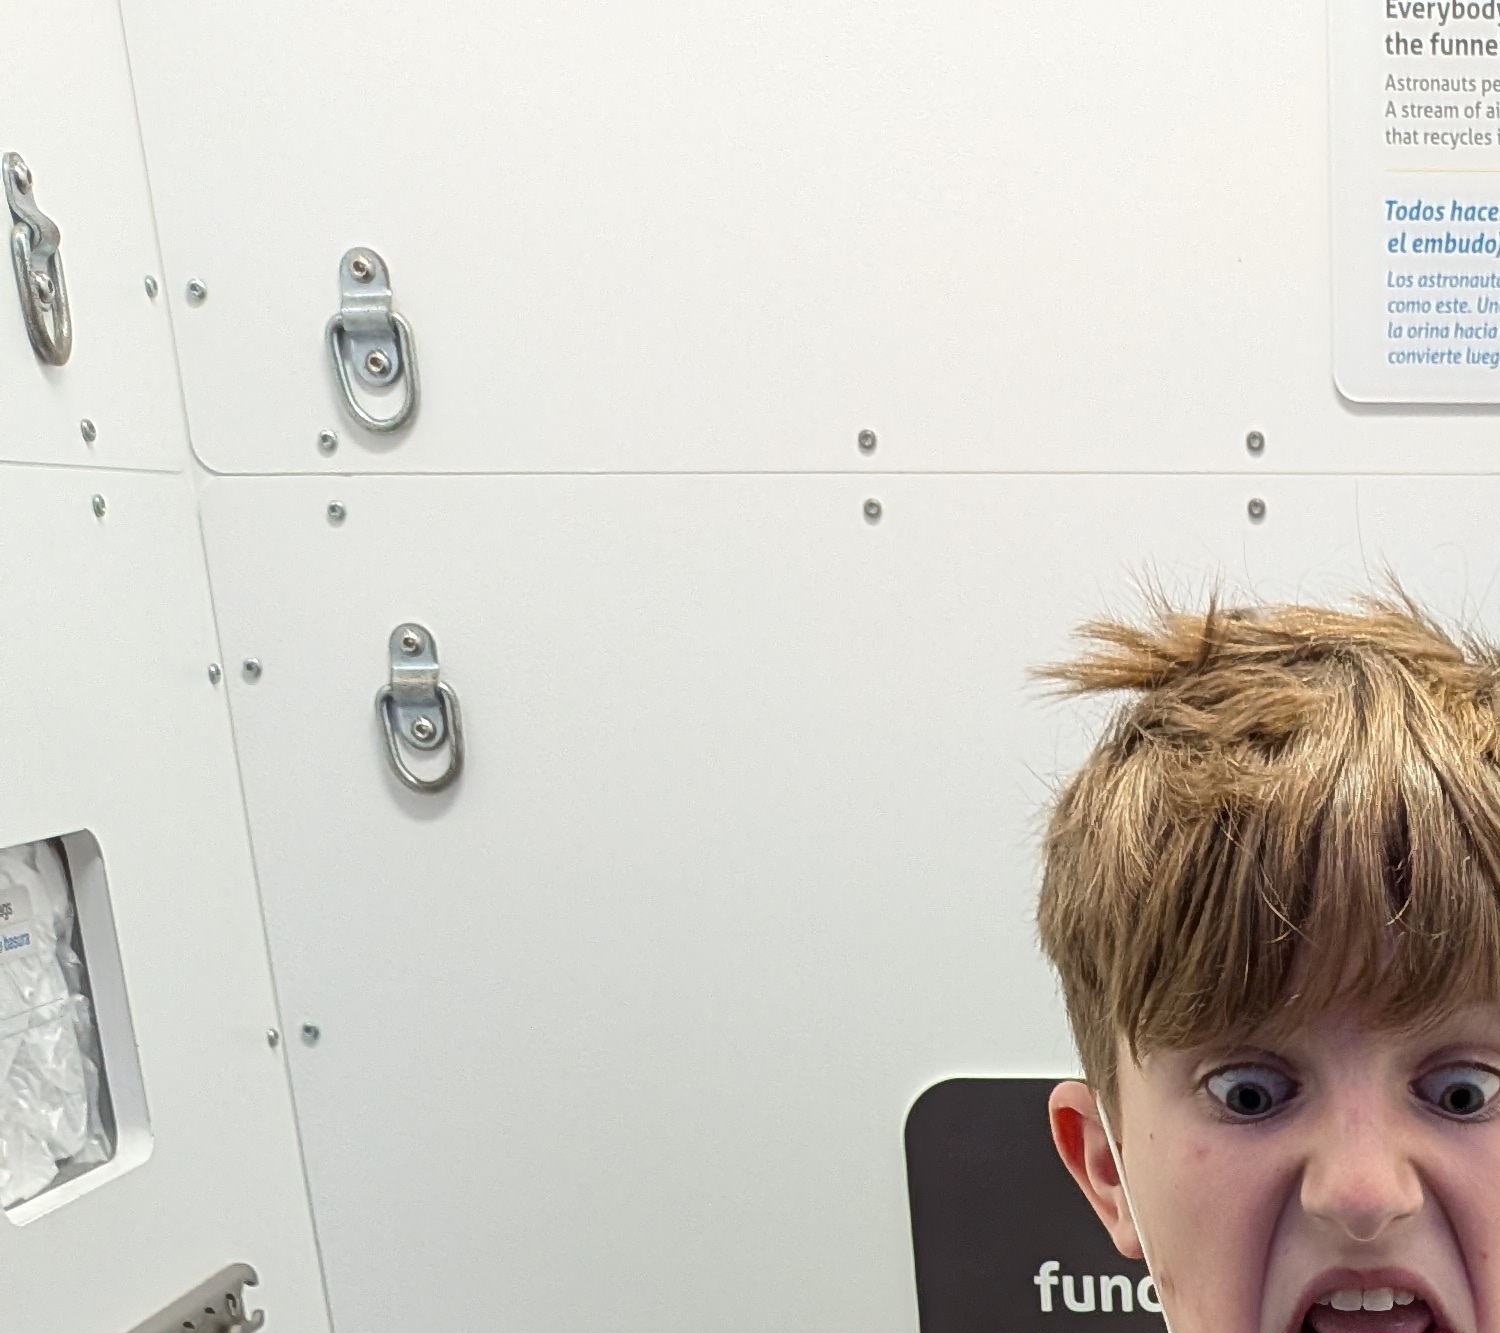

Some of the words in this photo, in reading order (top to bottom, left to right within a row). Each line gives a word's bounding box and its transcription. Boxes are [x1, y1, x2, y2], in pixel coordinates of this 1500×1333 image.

[1384, 31, 1424, 56] the
[1384, 73, 1477, 93] Astronauts
[1384, 100, 1397, 119] A
[1400, 102, 1460, 119] stream
[1463, 100, 1483, 120] of
[1385, 126, 1419, 146] that
[1423, 126, 1493, 151] recycles
[1385, 199, 1446, 222] Todos
[1387, 231, 1407, 254] el
[1386, 269, 1414, 289] Los
[1387, 298, 1432, 314] como
[1434, 297, 1473, 315] este.
[1387, 320, 1404, 340] la
[1406, 321, 1451, 340] orina
[1453, 321, 1499, 340] hacia
[1387, 347, 1463, 365] convierte
